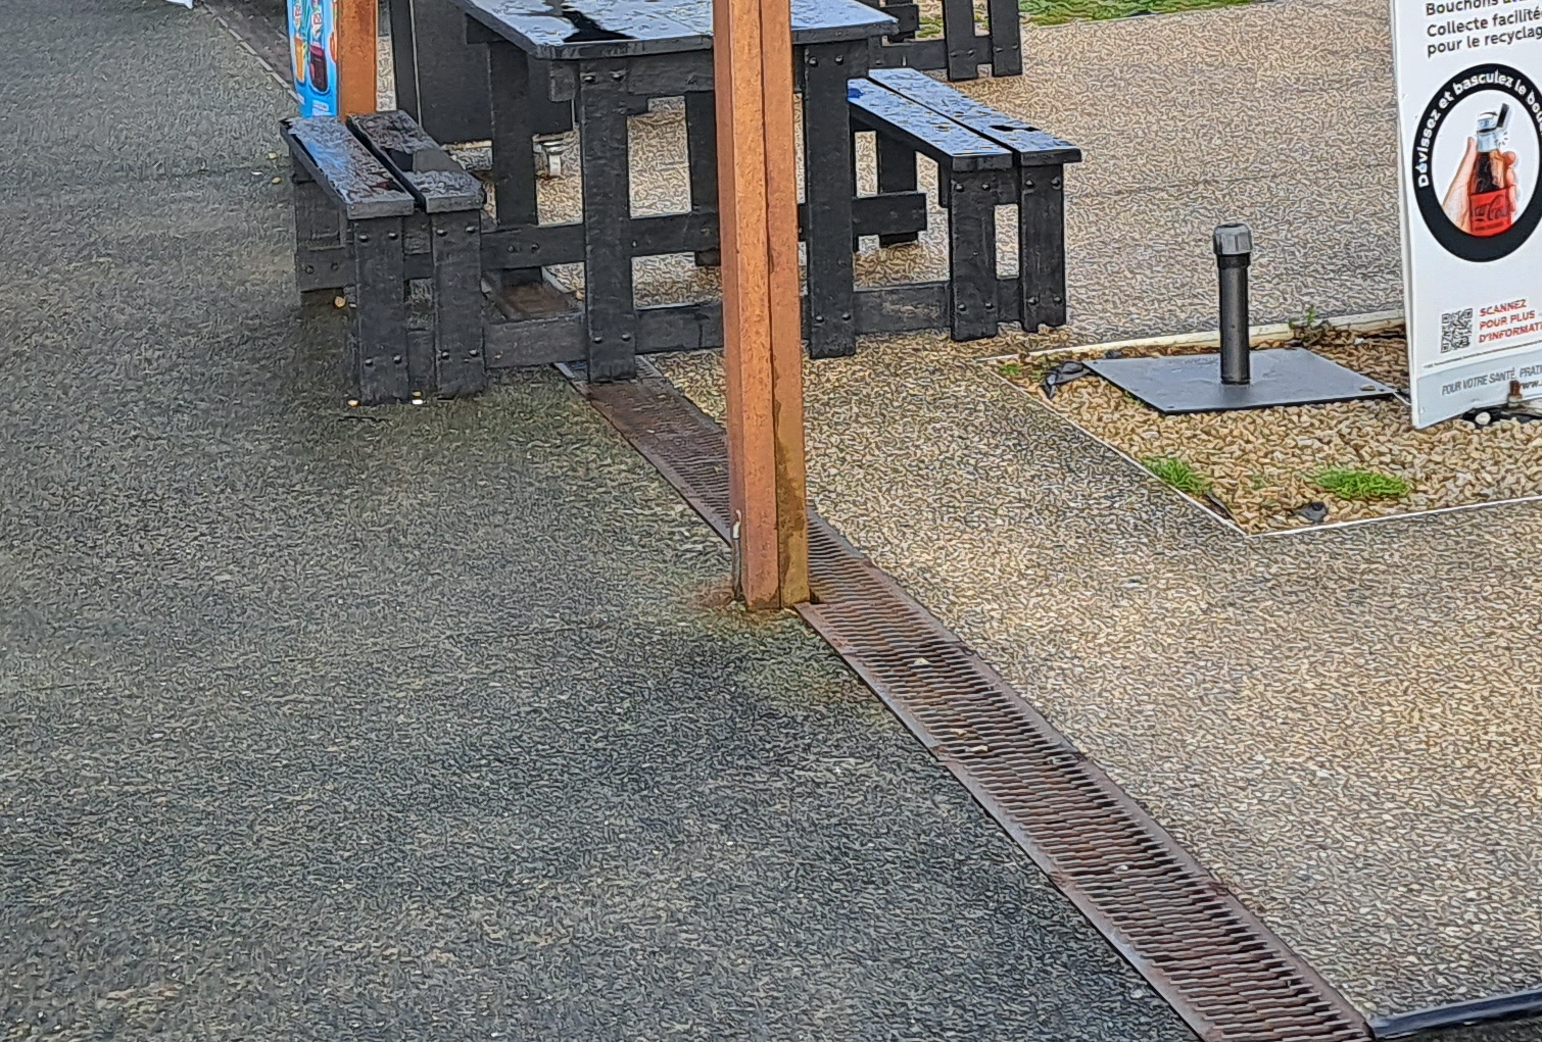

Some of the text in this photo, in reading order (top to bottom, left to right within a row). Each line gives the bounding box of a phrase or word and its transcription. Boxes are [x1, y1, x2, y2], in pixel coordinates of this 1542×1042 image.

[1427, 16, 1489, 38] Collecte
[1427, 39, 1463, 58] pour
[1467, 35, 1480, 49] le
[1414, 109, 1442, 188] Dévissez
[1439, 90, 1454, 109] et
[1453, 69, 1513, 94] basculez
[1514, 78, 1526, 96] le
[1479, 299, 1528, 318] SCANNEZ
[1479, 310, 1537, 330] POUR PLUS
